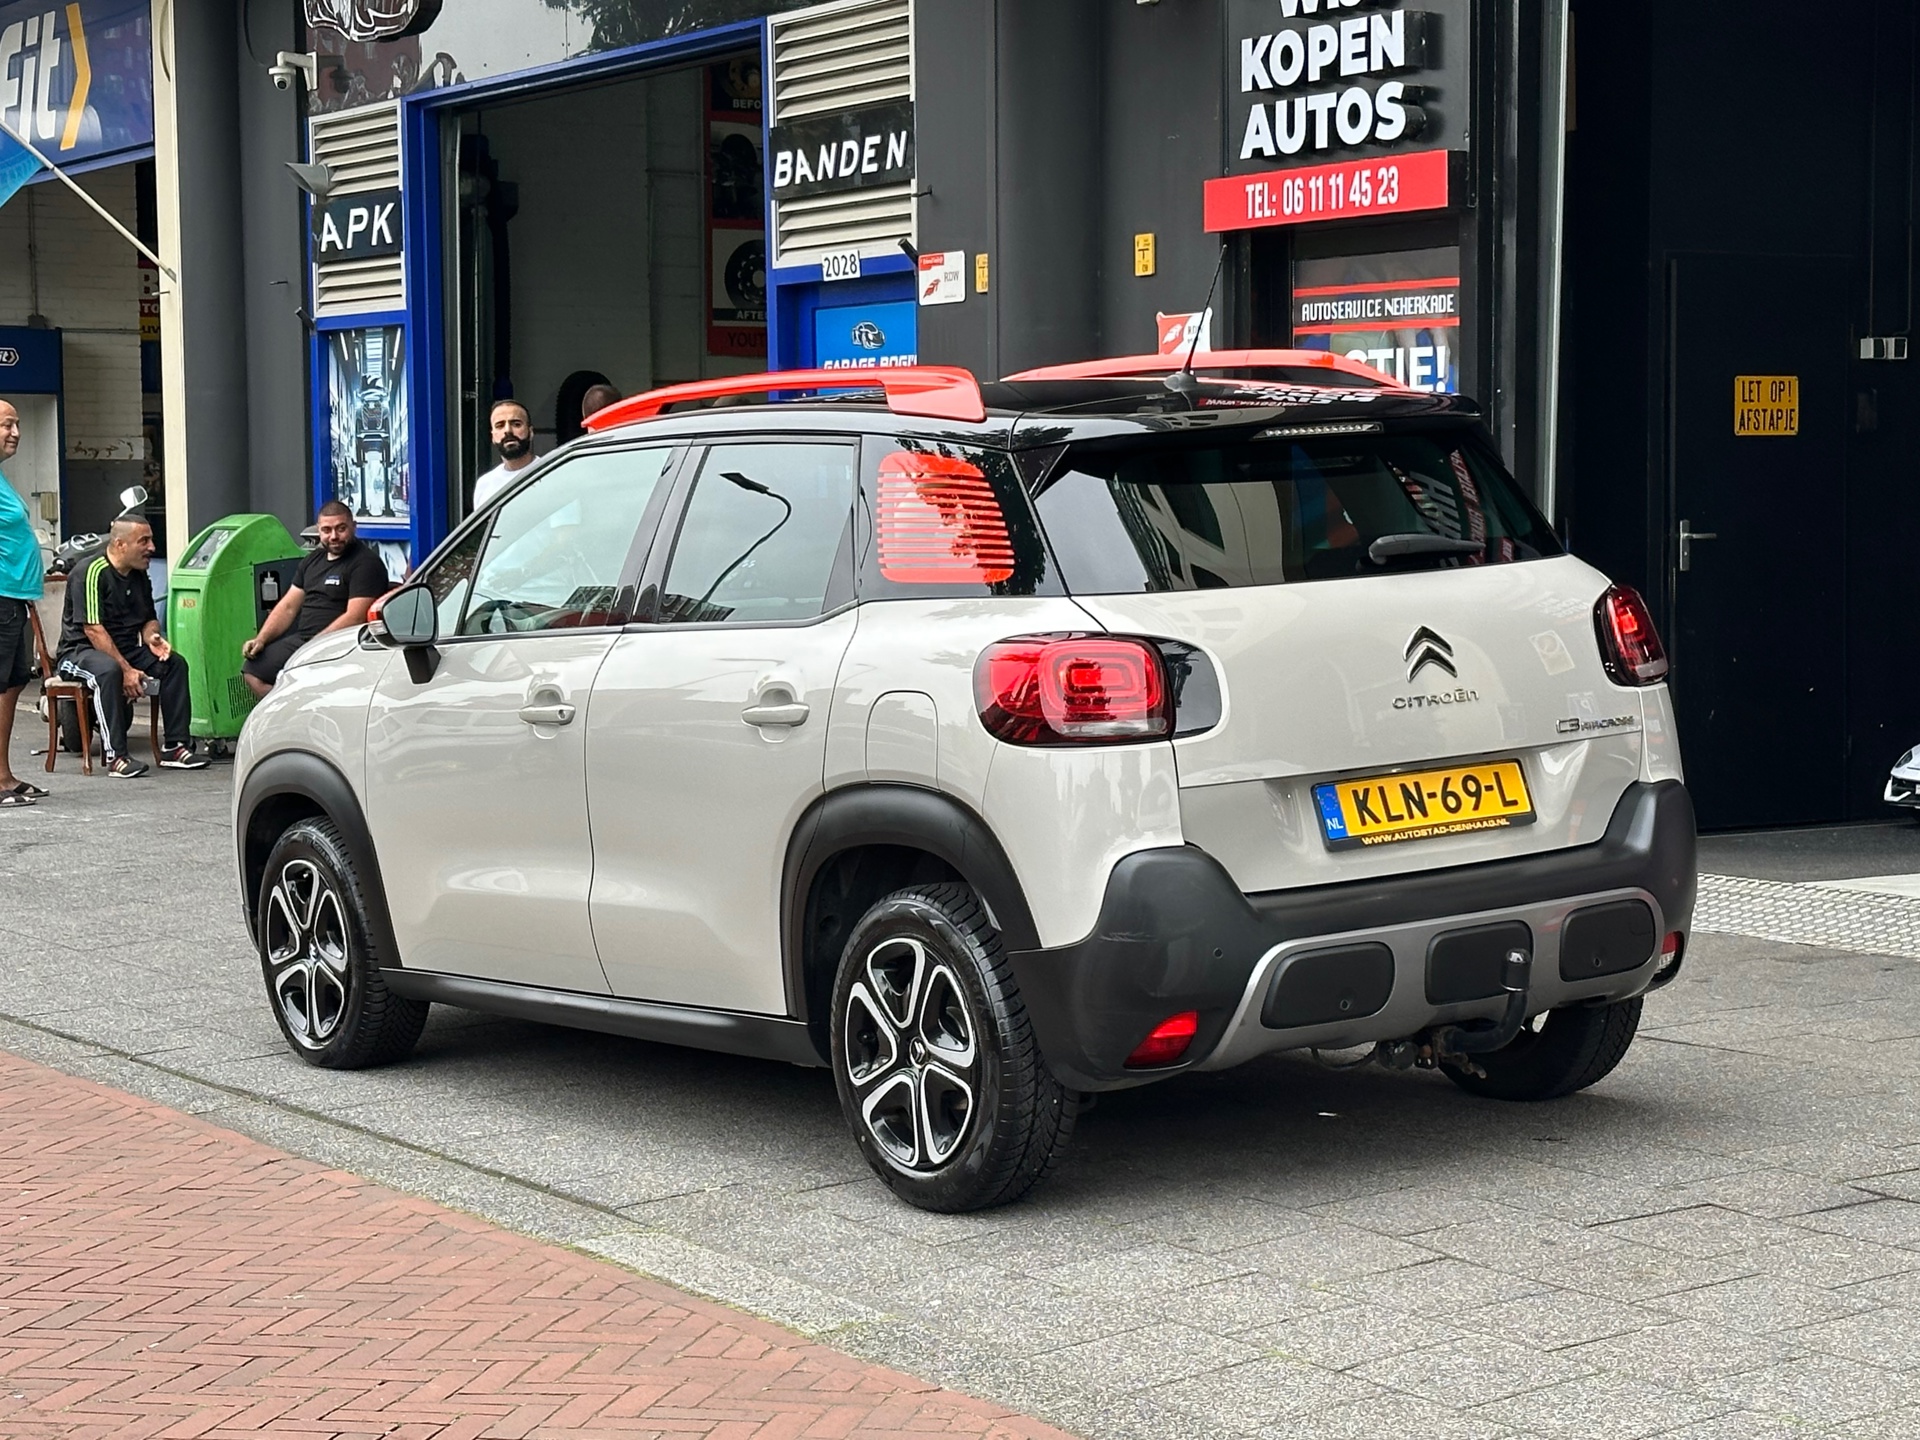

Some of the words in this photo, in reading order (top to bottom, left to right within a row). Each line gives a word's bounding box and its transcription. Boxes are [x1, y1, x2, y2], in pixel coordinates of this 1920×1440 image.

[1241, 9, 1405, 93] KOPEN
[732, 98, 762, 109] BEFO
[1239, 81, 1406, 160] AUTOS
[773, 130, 907, 188] BANDEN
[1245, 181, 1277, 220] TEL:
[1282, 177, 1304, 216] 06
[1308, 175, 1324, 212] 11
[1328, 172, 1344, 209] 11
[1349, 169, 1371, 207] 45
[1377, 165, 1399, 205] 23
[320, 202, 396, 252] APK
[823, 253, 858, 278] 2028
[736, 310, 767, 320] AFTE
[1301, 298, 1383, 322] AUTOSERVICE
[1384, 293, 1455, 317] NEHERKADE
[1741, 380, 1762, 403] LET
[1769, 380, 1792, 403] OP!
[1738, 408, 1796, 432] AFSTAPJE
[1556, 717, 1580, 733] C3
[1351, 771, 1519, 827] KLN-69-L
[1325, 817, 1344, 830] NL
[1361, 818, 1510, 845] WWW.AUTOSTAD-DENHAAG.NL
